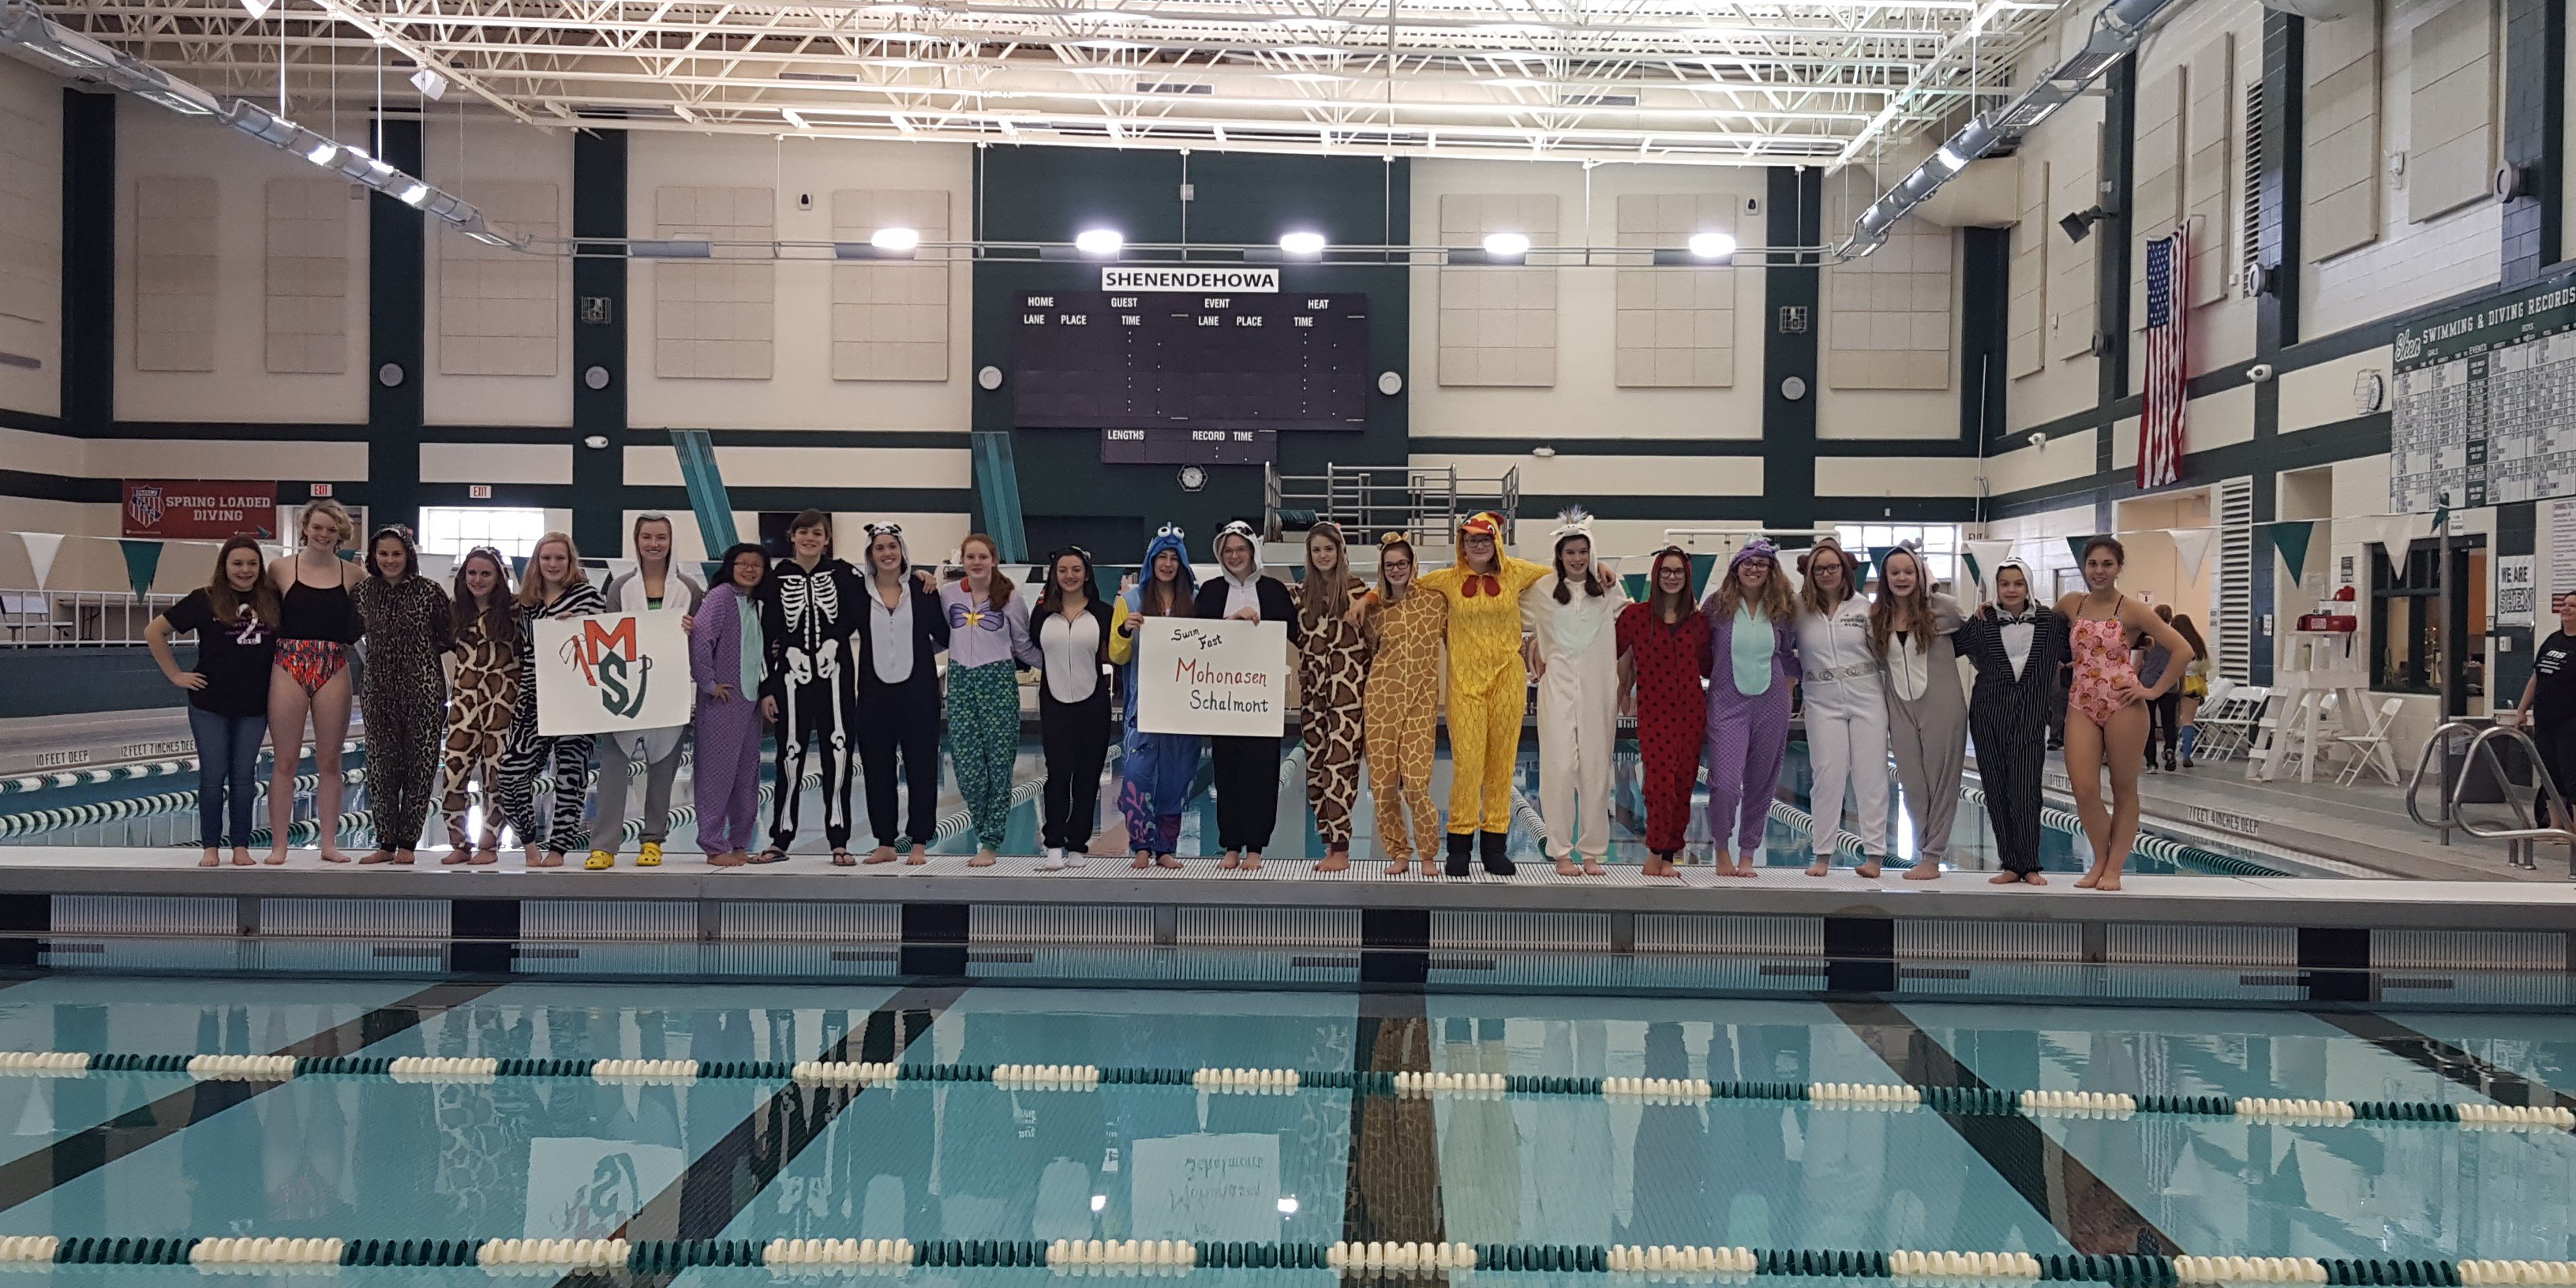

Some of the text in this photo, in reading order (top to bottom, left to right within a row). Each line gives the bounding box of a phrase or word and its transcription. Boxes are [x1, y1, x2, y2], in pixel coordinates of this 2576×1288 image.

[1106, 272, 1275, 287] SHENENDEHOWA
[1028, 297, 1329, 309] HOME GUEST EVENT HEAT
[1024, 314, 1313, 328] LANE PLACE TIME LANE PLACE TIME
[2423, 316, 2473, 344] SWIMMING
[2477, 313, 2484, 329] &
[2488, 302, 2524, 326] DIVING
[2528, 286, 2576, 315] RECORDS
[2394, 328, 2421, 363] Shen
[2469, 343, 2488, 355] EVENTS
[1108, 430, 1253, 441] LENGTHS RECORD TIME
[315, 485, 328, 495] EXIT
[474, 486, 487, 496] EXIT
[166, 496, 271, 507] SPRING LOADED
[193, 510, 243, 522] DIVING
[2501, 566, 2529, 582] WE ARE
[1171, 628, 1200, 642] Swim
[1198, 634, 1223, 650] Fast
[1175, 657, 1267, 687] Mohonasen
[1189, 689, 1269, 713] Schalmont
[121, 746, 128, 758] 12
[129, 744, 147, 757] FEET
[155, 742, 179, 754] INCHES
[181, 739, 197, 751] DEE
[36, 750, 88, 766] 10 FEET DEEP
[2216, 811, 2239, 830] INCHES
[2241, 818, 2259, 834] DEEP
